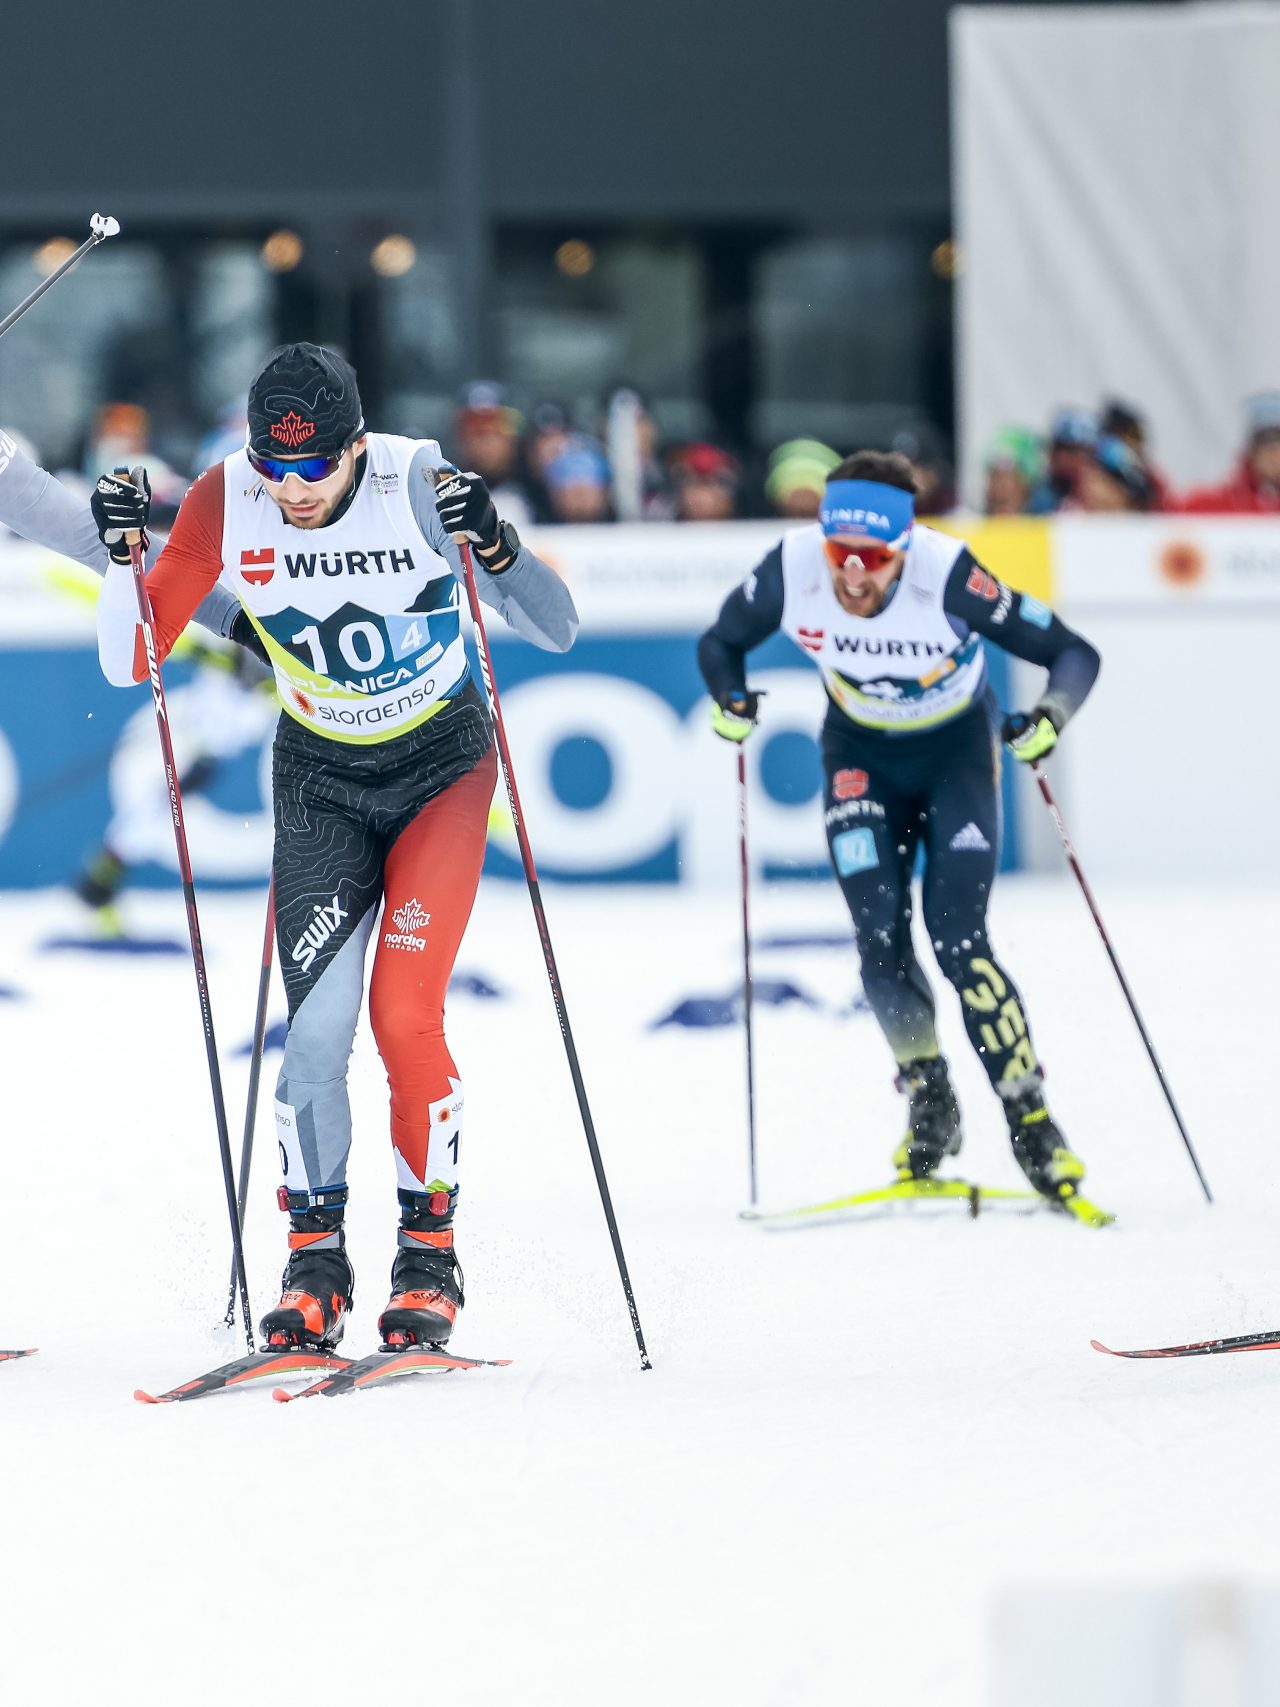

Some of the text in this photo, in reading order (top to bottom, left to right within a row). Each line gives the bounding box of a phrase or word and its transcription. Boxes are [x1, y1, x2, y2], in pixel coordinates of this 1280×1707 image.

[284, 549, 416, 578] WÜRTH
[291, 621, 385, 675] 10
[400, 620, 423, 650] 4
[834, 635, 943, 657] WÜRTH
[292, 667, 414, 694] PLANICA
[319, 679, 435, 726] storaenso
[384, 933, 427, 951] nordiq
[386, 942, 417, 952] CANADA
[447, 1129, 459, 1165] 1
